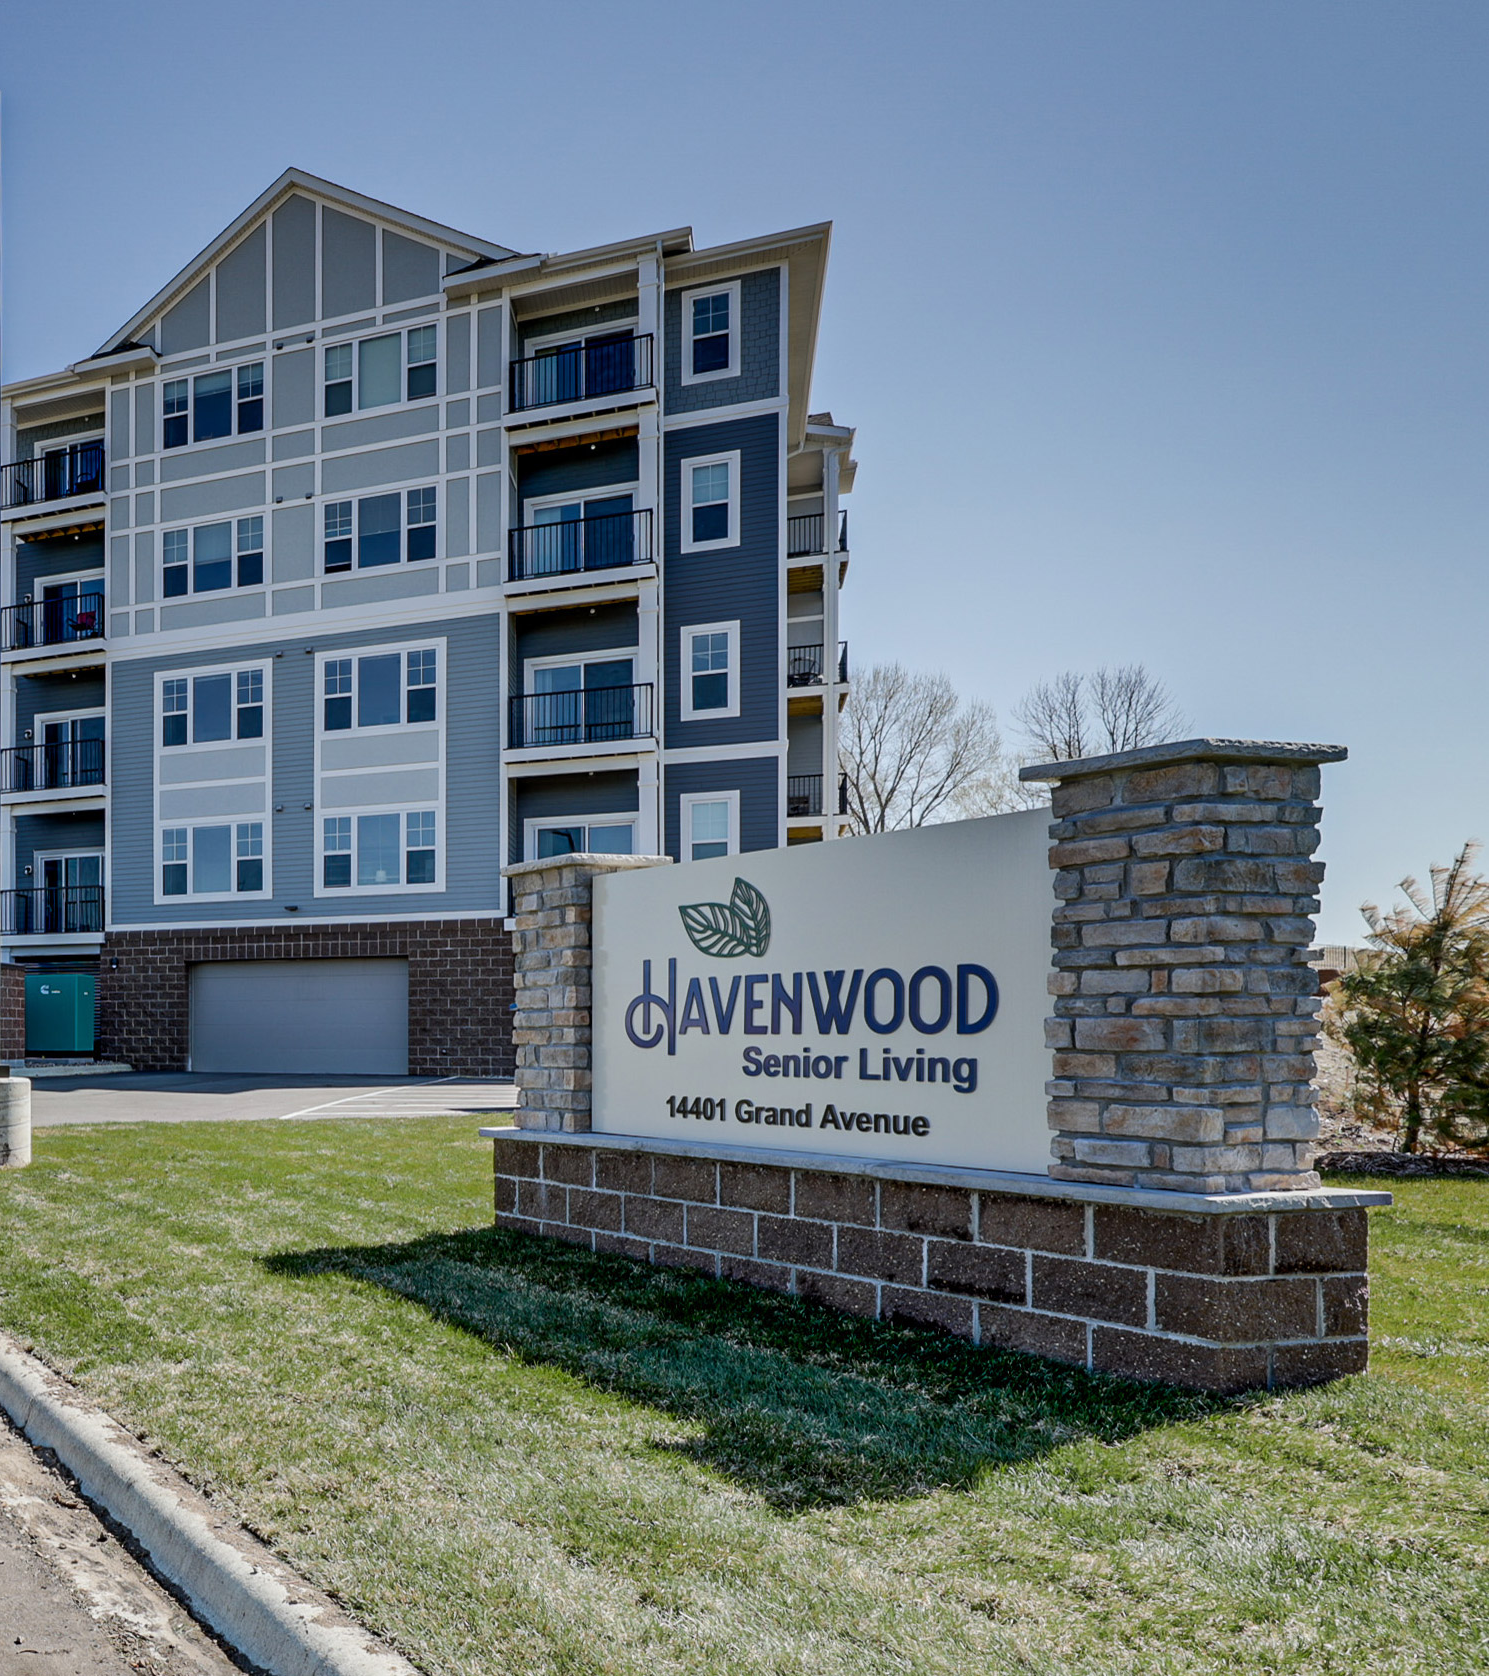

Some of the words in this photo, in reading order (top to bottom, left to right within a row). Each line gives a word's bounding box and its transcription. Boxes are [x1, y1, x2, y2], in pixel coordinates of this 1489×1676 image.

[625, 957, 1000, 1055] HAVENWOOD
[742, 1046, 849, 1078] Senior
[859, 1048, 978, 1093] Living
[666, 1095, 726, 1121] 14401
[735, 1099, 811, 1129] Grand
[820, 1104, 930, 1136] Avenue
